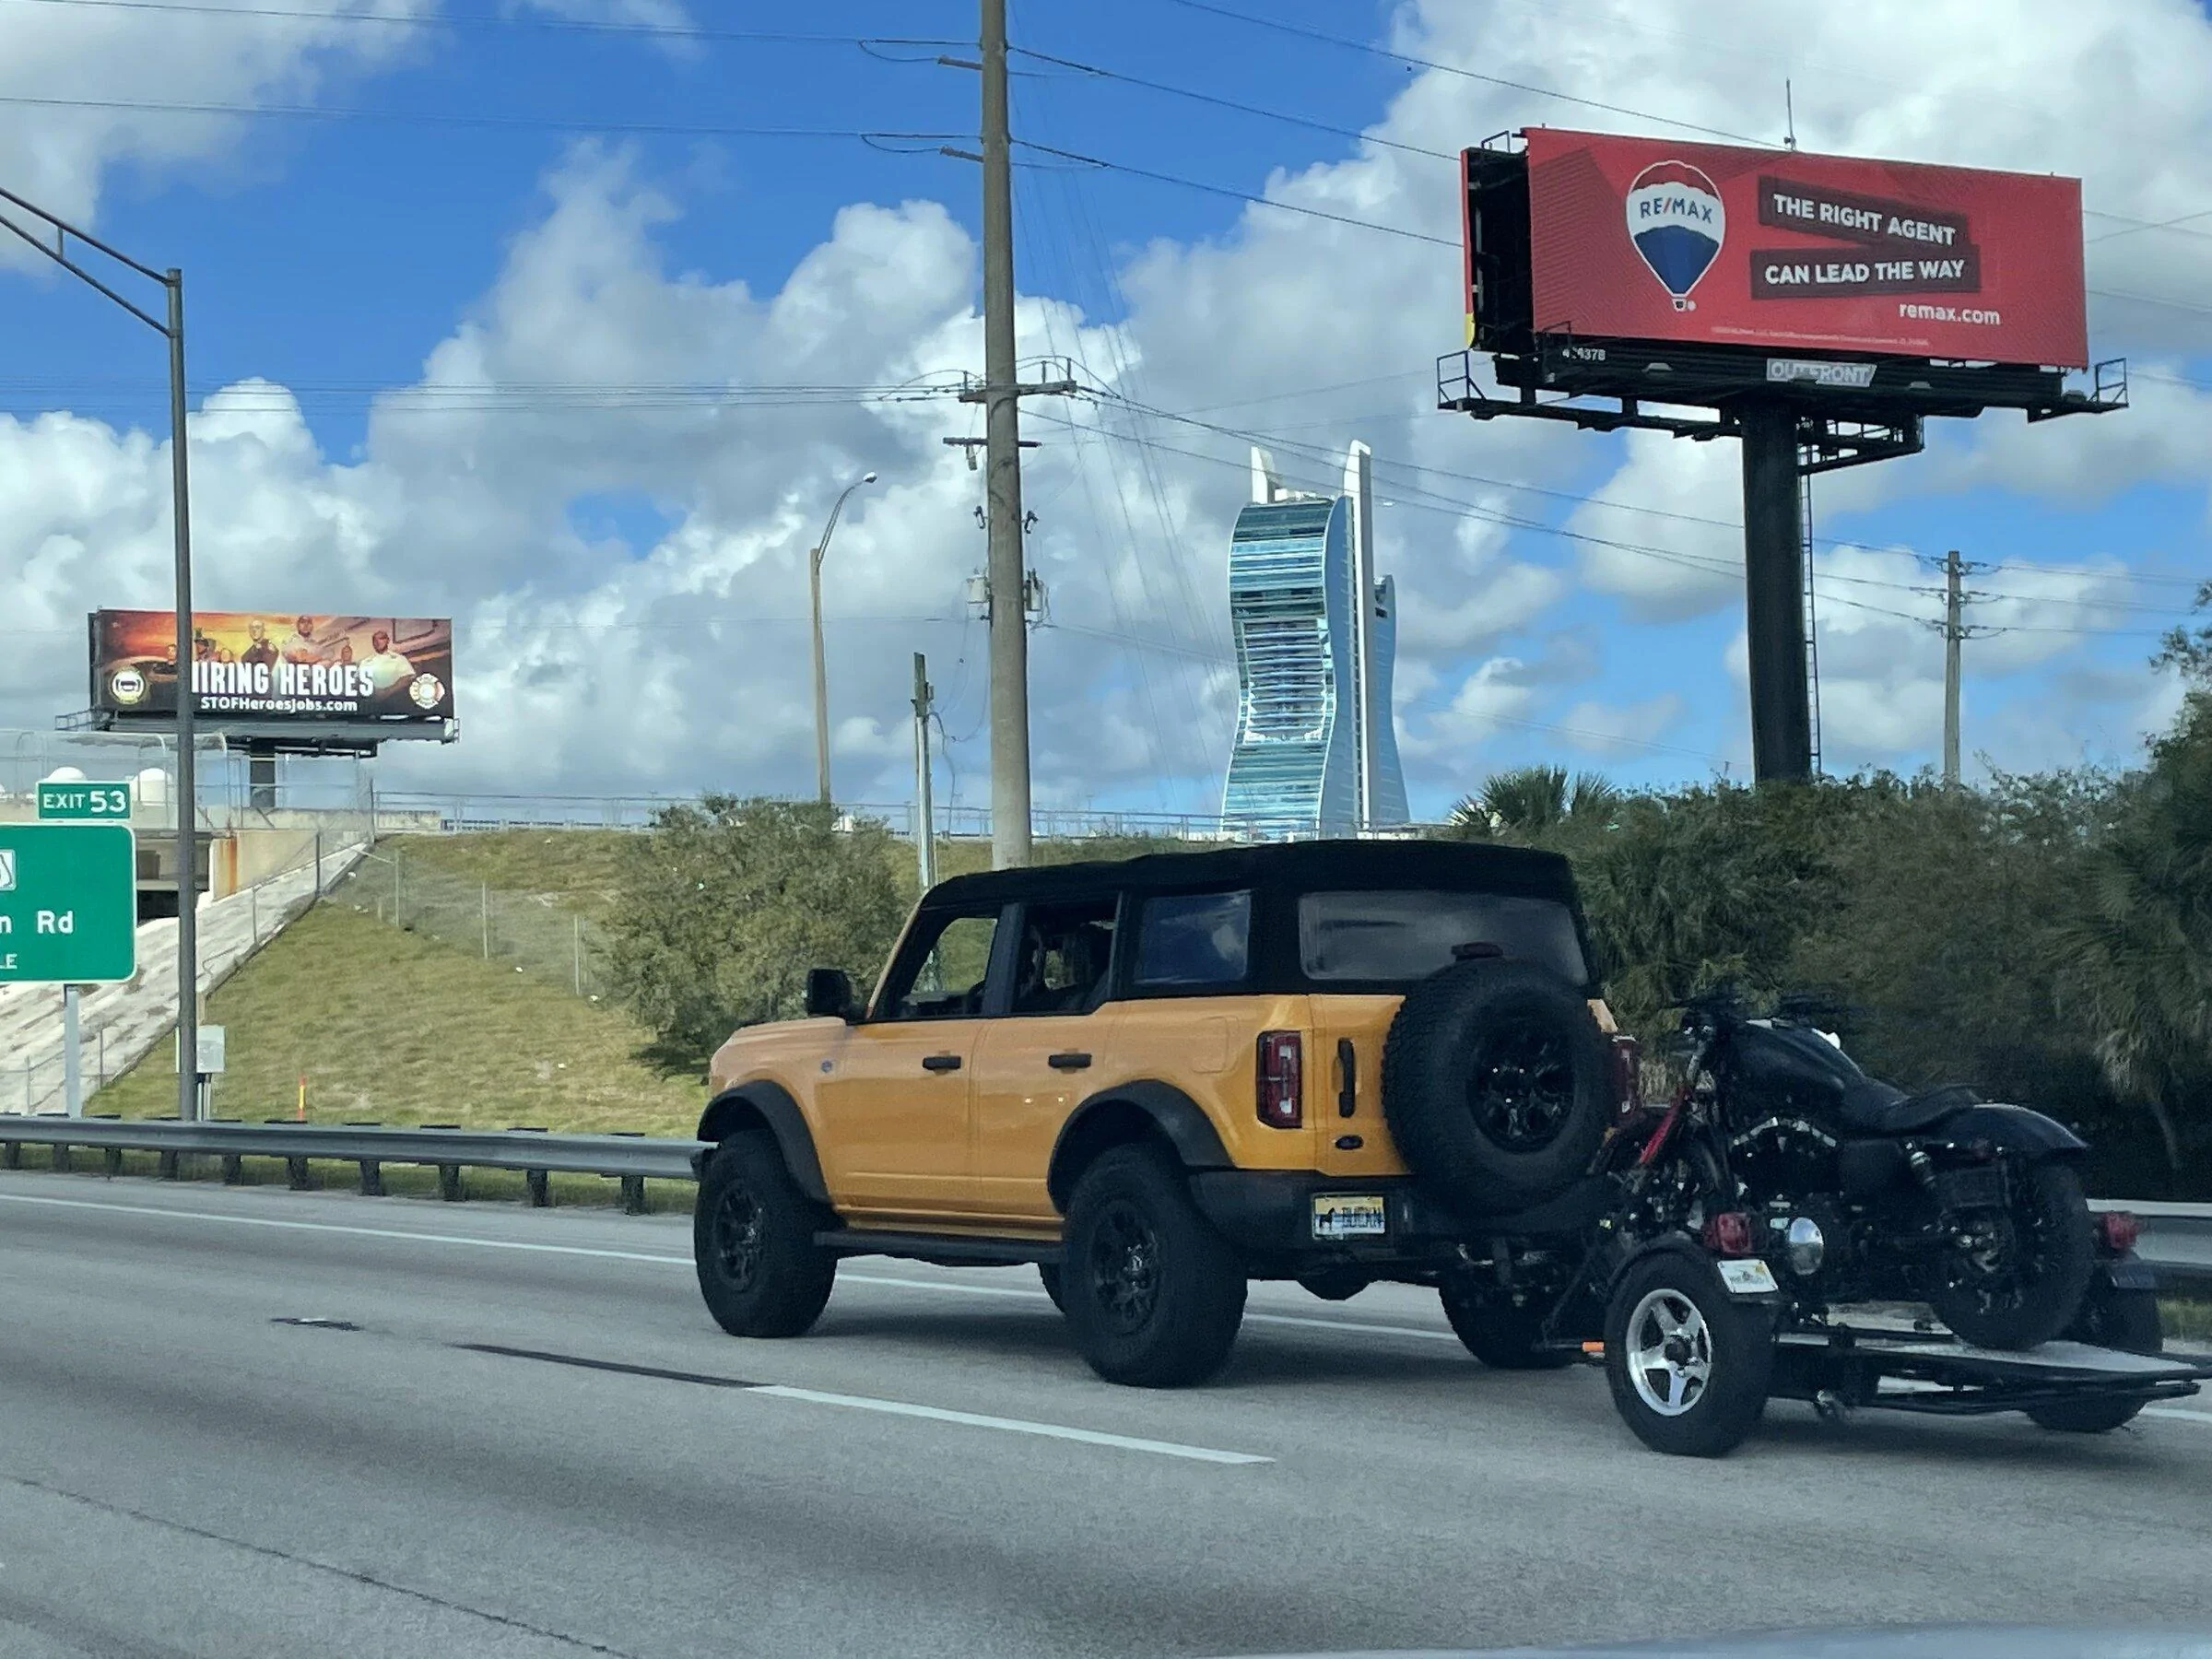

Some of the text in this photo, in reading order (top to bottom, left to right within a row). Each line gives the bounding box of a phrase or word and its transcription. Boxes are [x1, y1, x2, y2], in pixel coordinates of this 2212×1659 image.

[1640, 197, 1712, 224] RE/MAX
[1773, 194, 1956, 245] THE RIGHT AGENT
[1765, 259, 1965, 284] CAN LEAD THE WAY
[1899, 302, 2001, 325] remax.com
[279, 663, 374, 697] HEROES
[43, 791, 126, 812] EXIT 53
[38, 910, 73, 934] Rd
